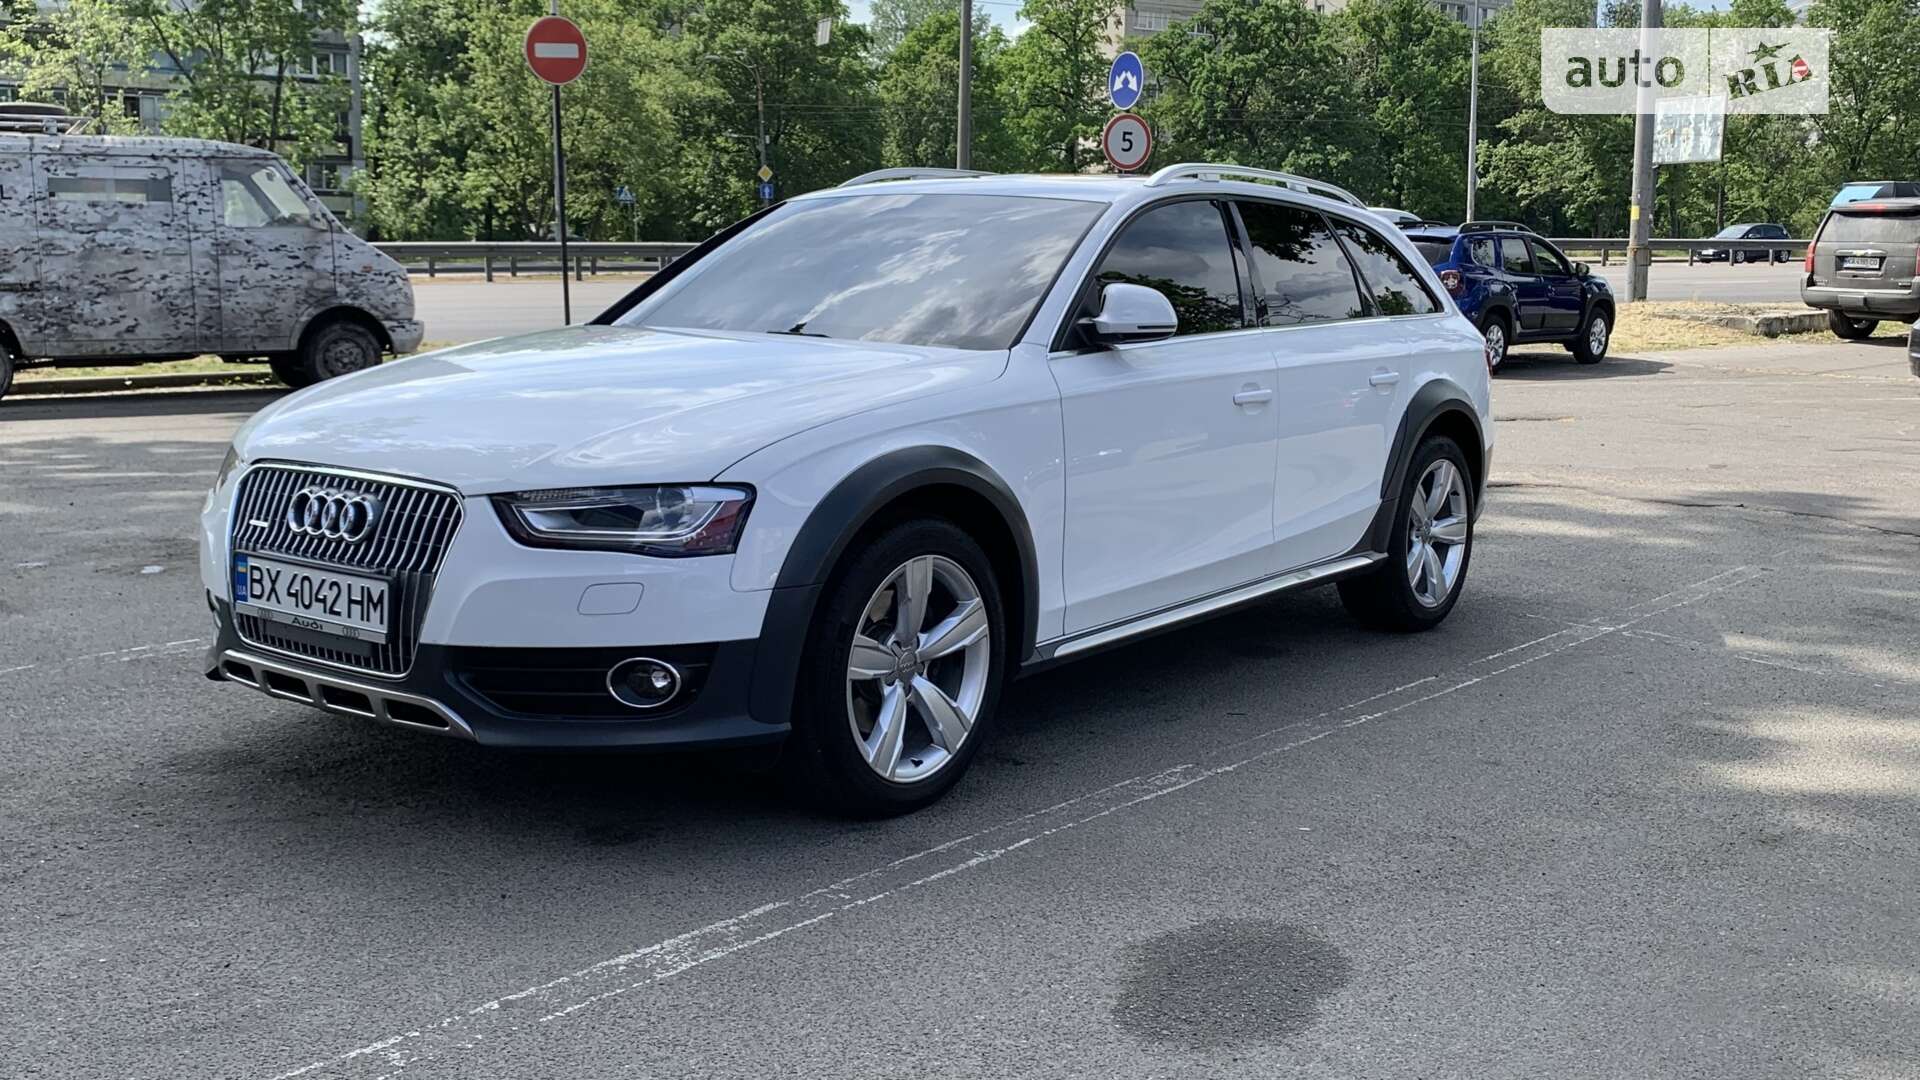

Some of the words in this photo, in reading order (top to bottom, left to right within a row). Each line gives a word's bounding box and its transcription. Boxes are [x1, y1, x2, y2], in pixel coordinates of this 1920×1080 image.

[1120, 130, 1134, 153] 5
[236, 585, 247, 597] UA
[249, 564, 281, 605] BX
[286, 573, 342, 617] 4042
[347, 583, 385, 626] HM
[291, 616, 324, 631] Audi
